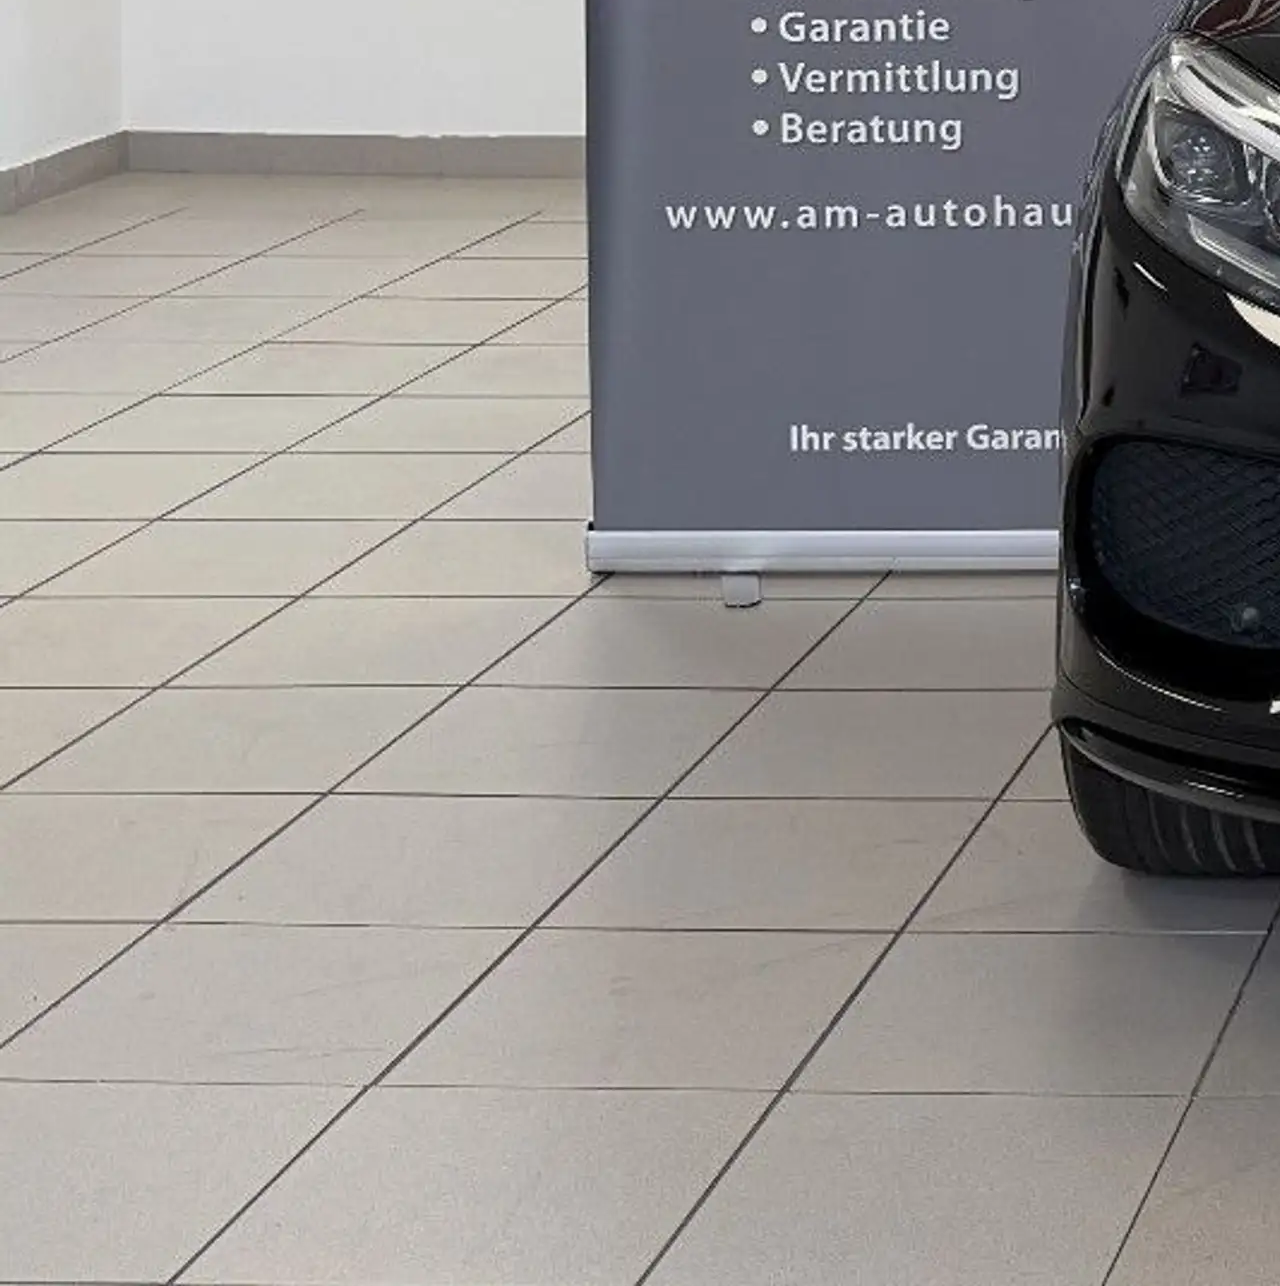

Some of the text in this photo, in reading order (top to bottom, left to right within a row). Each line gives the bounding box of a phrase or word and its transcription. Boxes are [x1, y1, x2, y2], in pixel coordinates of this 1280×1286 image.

[778, 10, 951, 43] Garantie
[778, 60, 1020, 100] Vermittlung
[780, 112, 963, 151] Beratung
[664, 194, 1074, 230] www.am-autohau
[790, 422, 1067, 452] Ihr starker Garan
